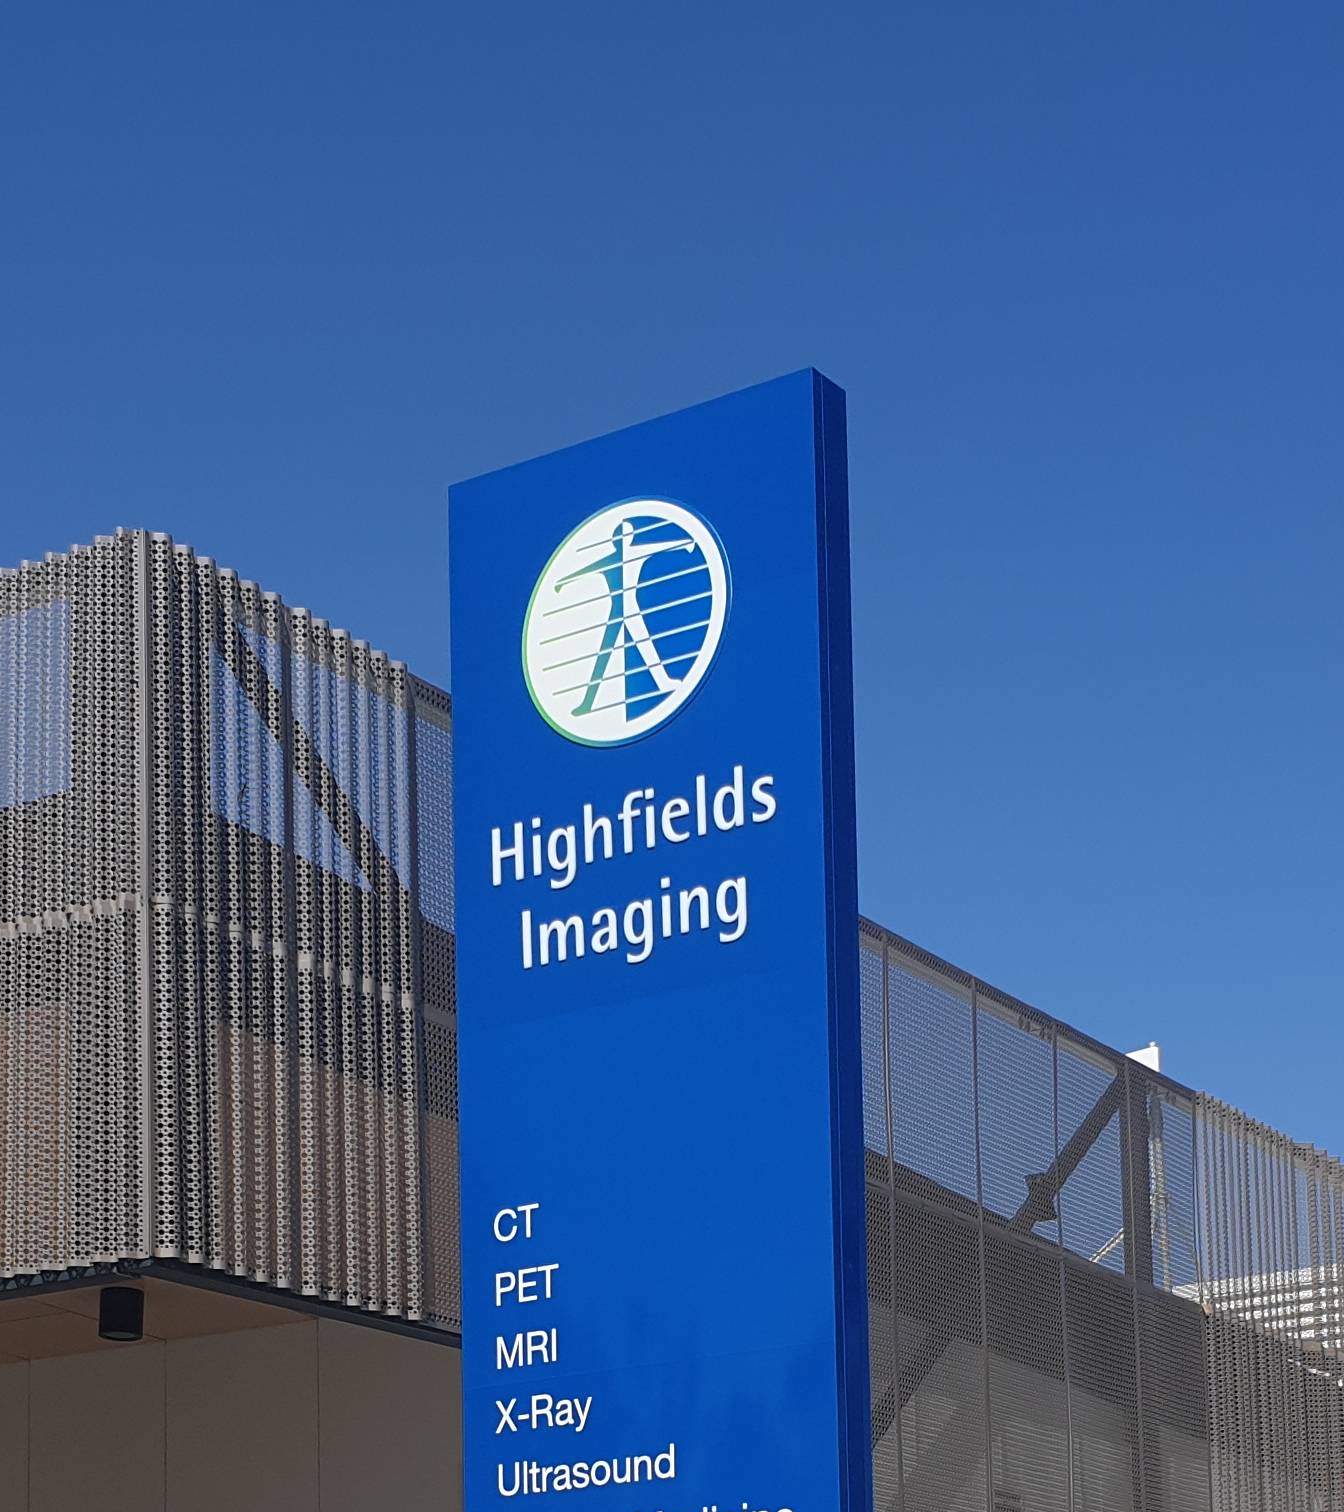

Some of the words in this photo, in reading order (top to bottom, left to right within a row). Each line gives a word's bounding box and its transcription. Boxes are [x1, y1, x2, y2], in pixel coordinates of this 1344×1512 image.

[491, 765, 777, 888] Highfields
[520, 876, 749, 969] Imaging
[493, 1203, 539, 1242] CT
[495, 1263, 559, 1306] PET
[495, 1328, 558, 1369] MRI
[495, 1394, 593, 1434] X-Ray
[497, 1443, 676, 1497] Ultrasound
